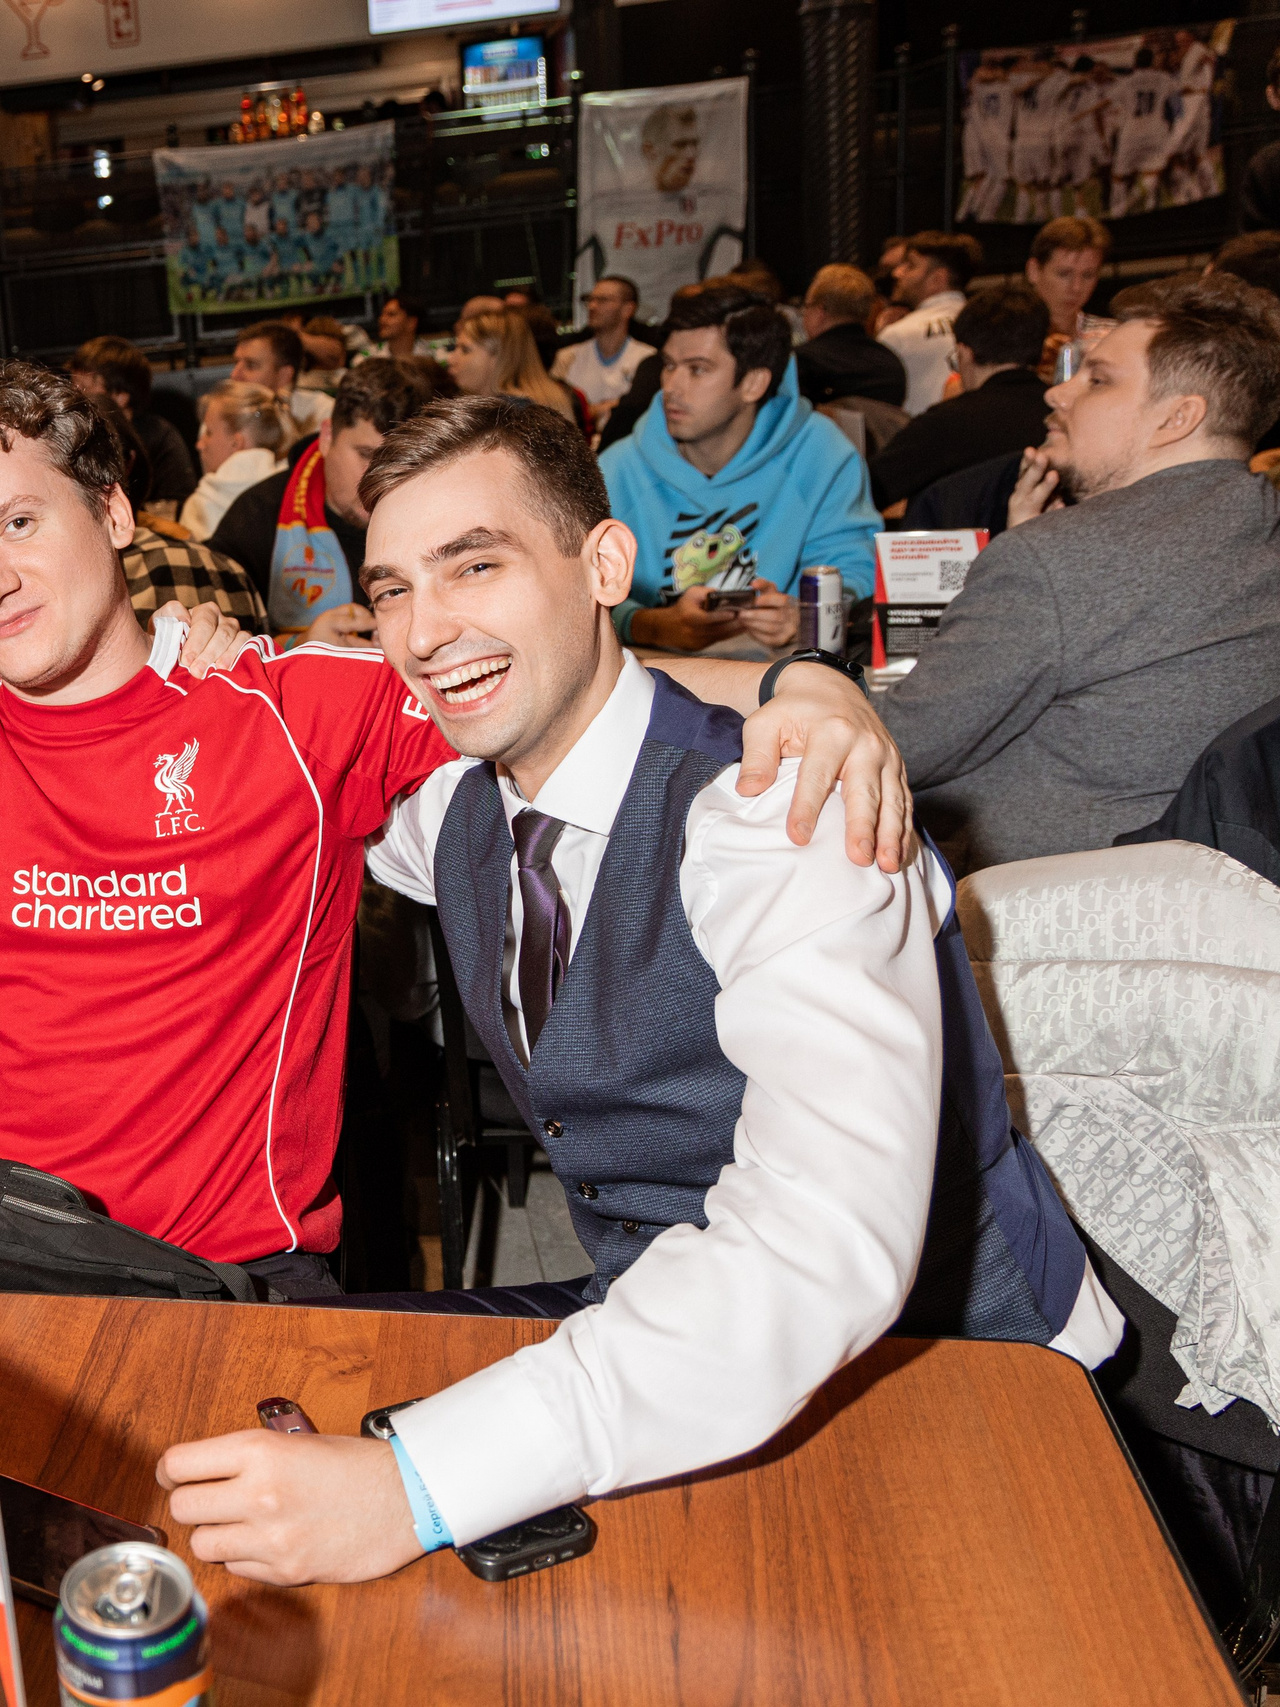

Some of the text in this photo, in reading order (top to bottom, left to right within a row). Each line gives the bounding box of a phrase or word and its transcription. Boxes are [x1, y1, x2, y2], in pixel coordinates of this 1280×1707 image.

[613, 218, 703, 249] FxPro
[155, 813, 205, 838] L.F.C.
[12, 863, 188, 898] standard
[11, 897, 203, 931] chartered
